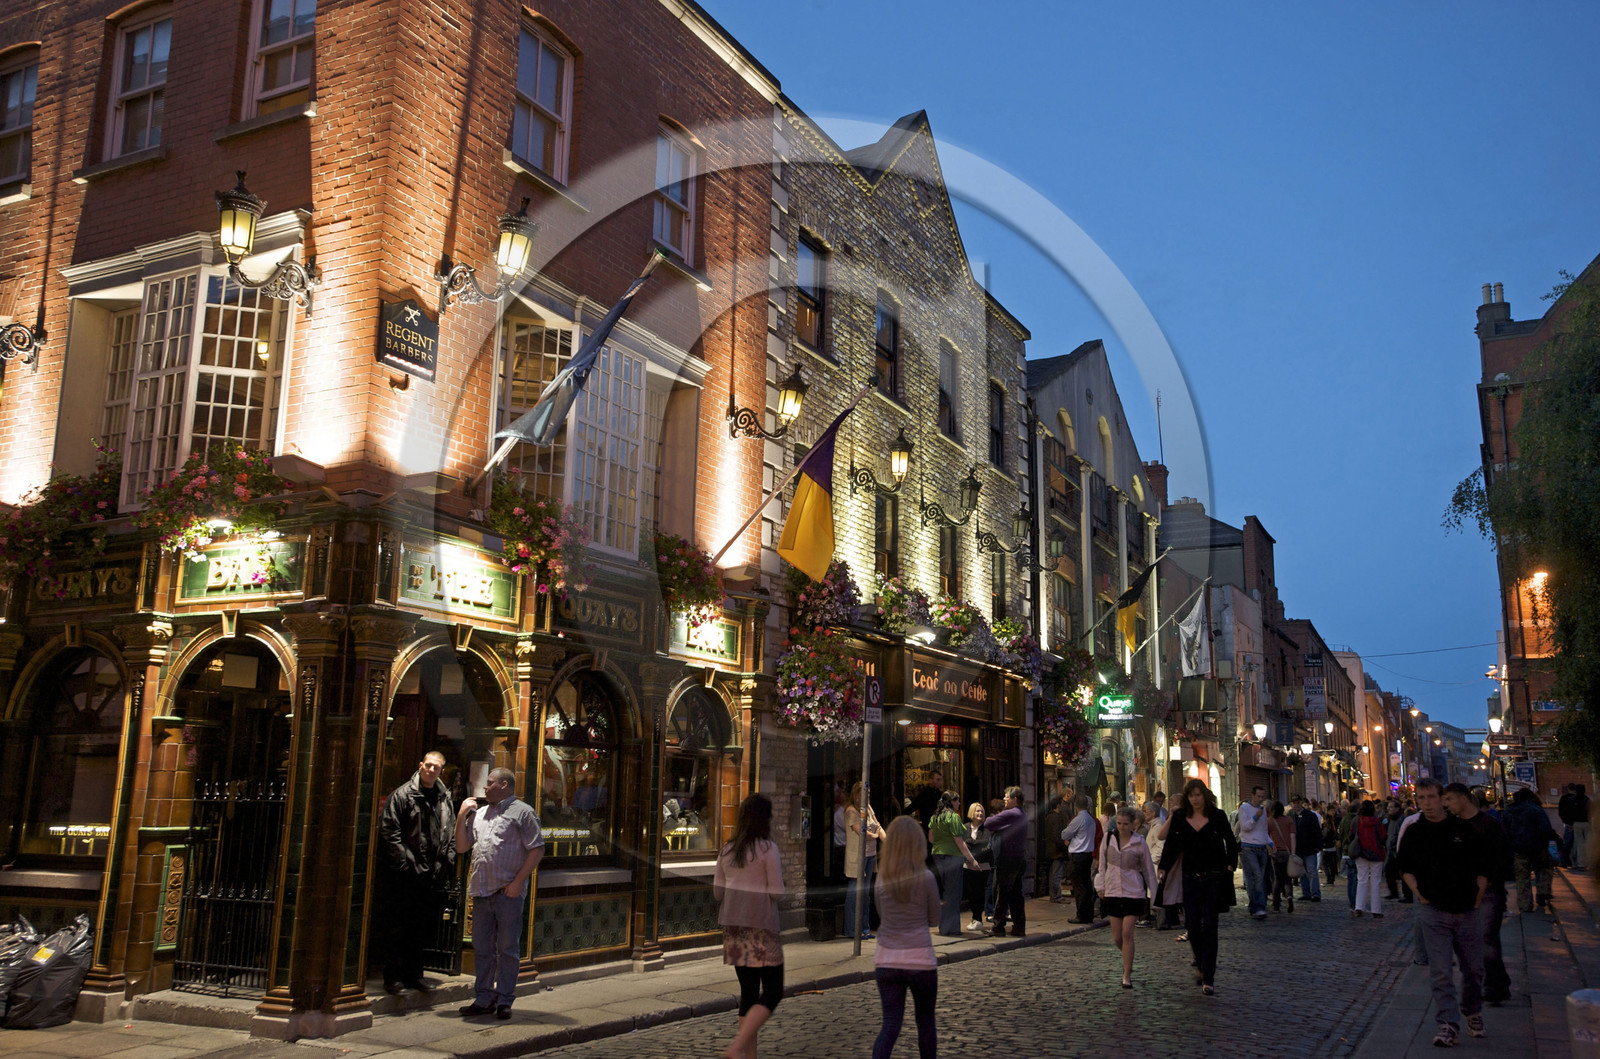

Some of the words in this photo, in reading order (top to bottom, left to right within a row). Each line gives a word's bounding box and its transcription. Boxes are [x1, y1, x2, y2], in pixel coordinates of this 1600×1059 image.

[386, 320, 435, 352] REGENT
[385, 337, 434, 364] BARBERS
[206, 554, 272, 588] BAR
[559, 595, 638, 632] QUAYS
[943, 681, 958, 695] na
[1099, 695, 1132, 709] Quays
[49, 826, 67, 836] THE
[67, 826, 93, 836] QUAYS
